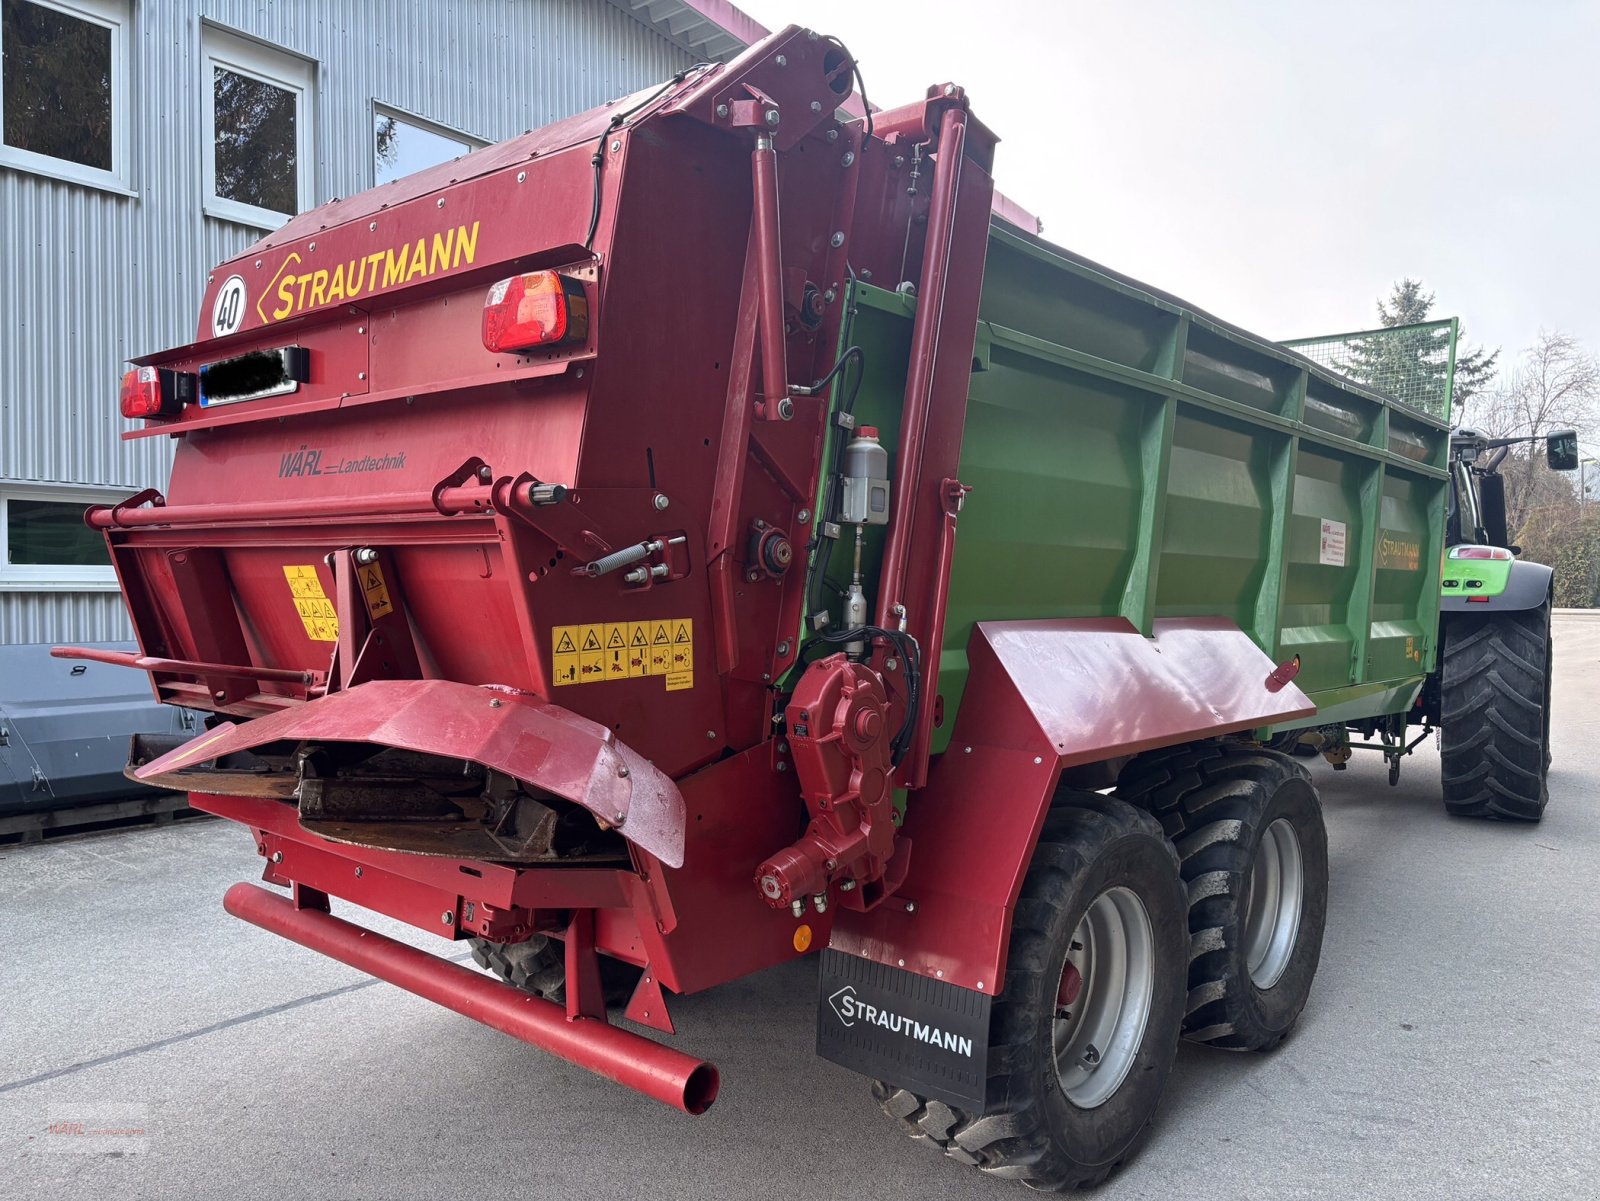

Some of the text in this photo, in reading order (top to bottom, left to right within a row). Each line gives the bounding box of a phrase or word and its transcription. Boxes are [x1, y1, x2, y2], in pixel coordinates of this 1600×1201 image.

[273, 221, 480, 320] STRAUTMANN
[215, 287, 241, 332] 40
[278, 445, 407, 478] WÄRL Landtechnik
[841, 995, 973, 1059] STRAUTMANN
